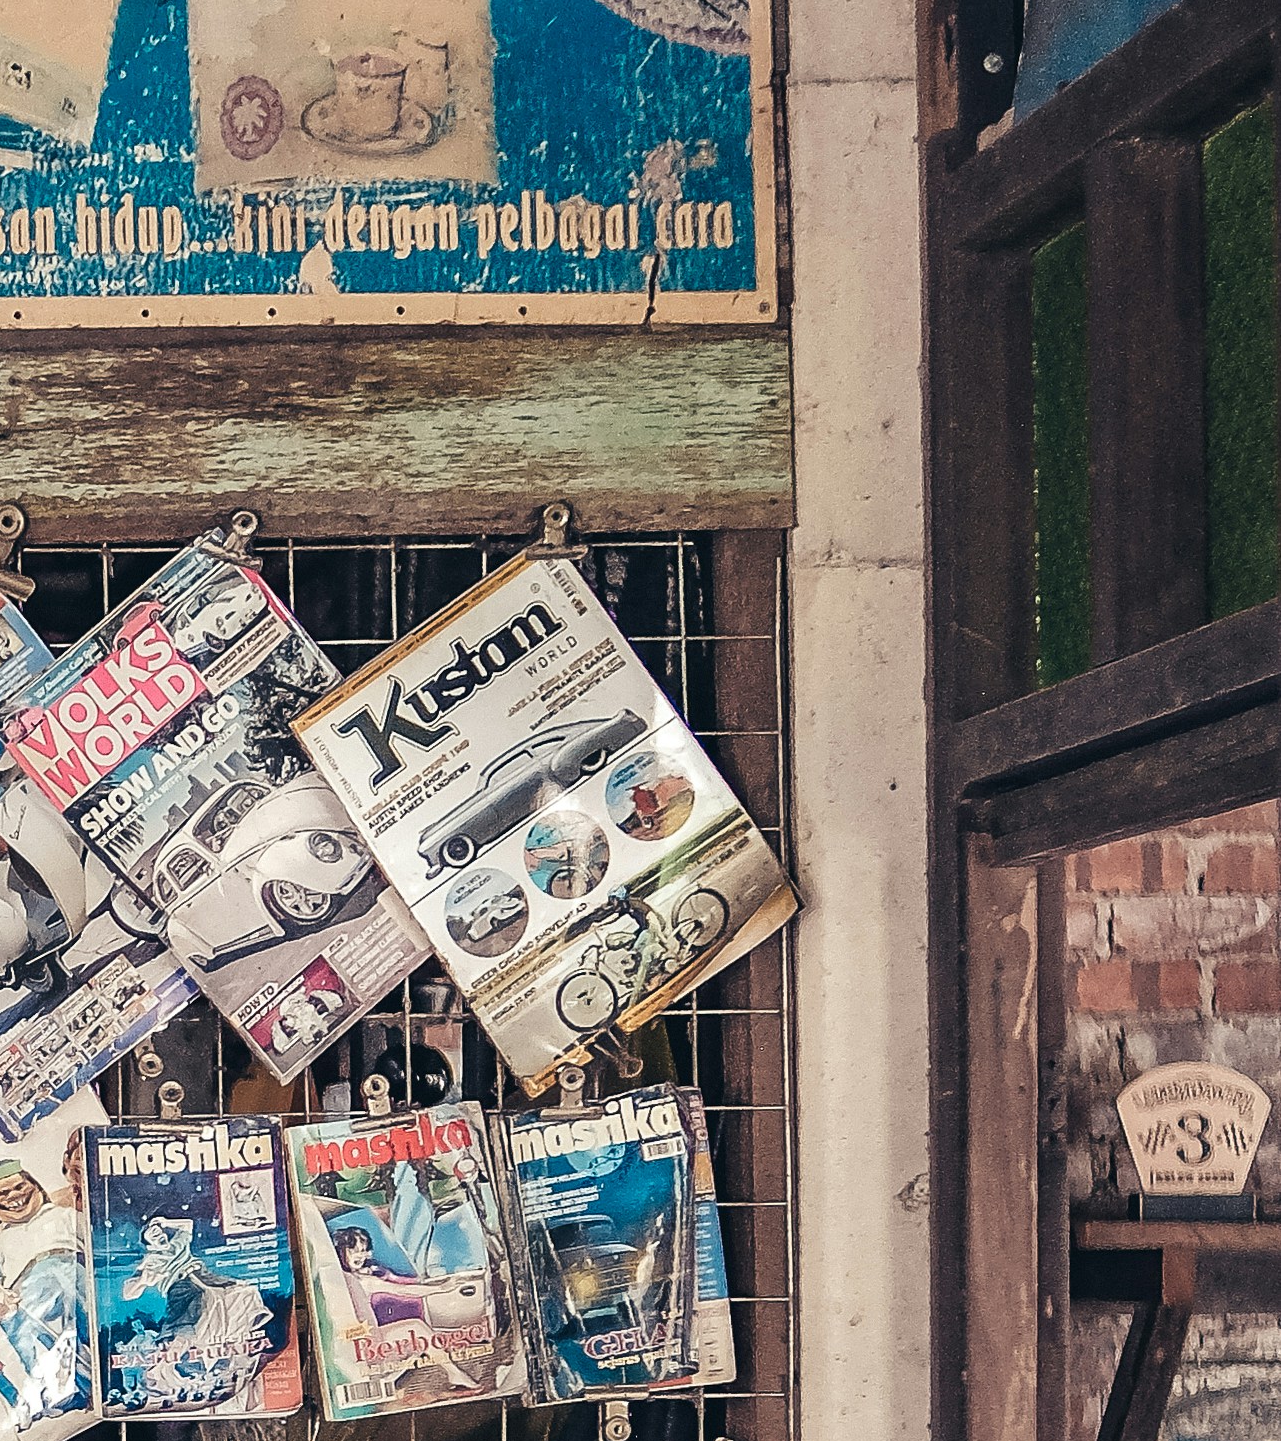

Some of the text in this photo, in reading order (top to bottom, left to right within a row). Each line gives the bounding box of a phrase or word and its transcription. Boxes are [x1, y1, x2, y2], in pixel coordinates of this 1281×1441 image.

[523, 634, 580, 679] WORLD
[11, 622, 185, 775] VOLKS
[36, 656, 209, 807] WORLD
[339, 601, 564, 794] Kustom
[76, 765, 161, 840] SHOW
[147, 722, 212, 782] AND
[198, 692, 244, 736] GO
[235, 984, 277, 1022] HOW TO
[97, 1123, 274, 1177] mastika
[304, 1114, 472, 1175] mastika
[511, 1092, 682, 1164] mastika
